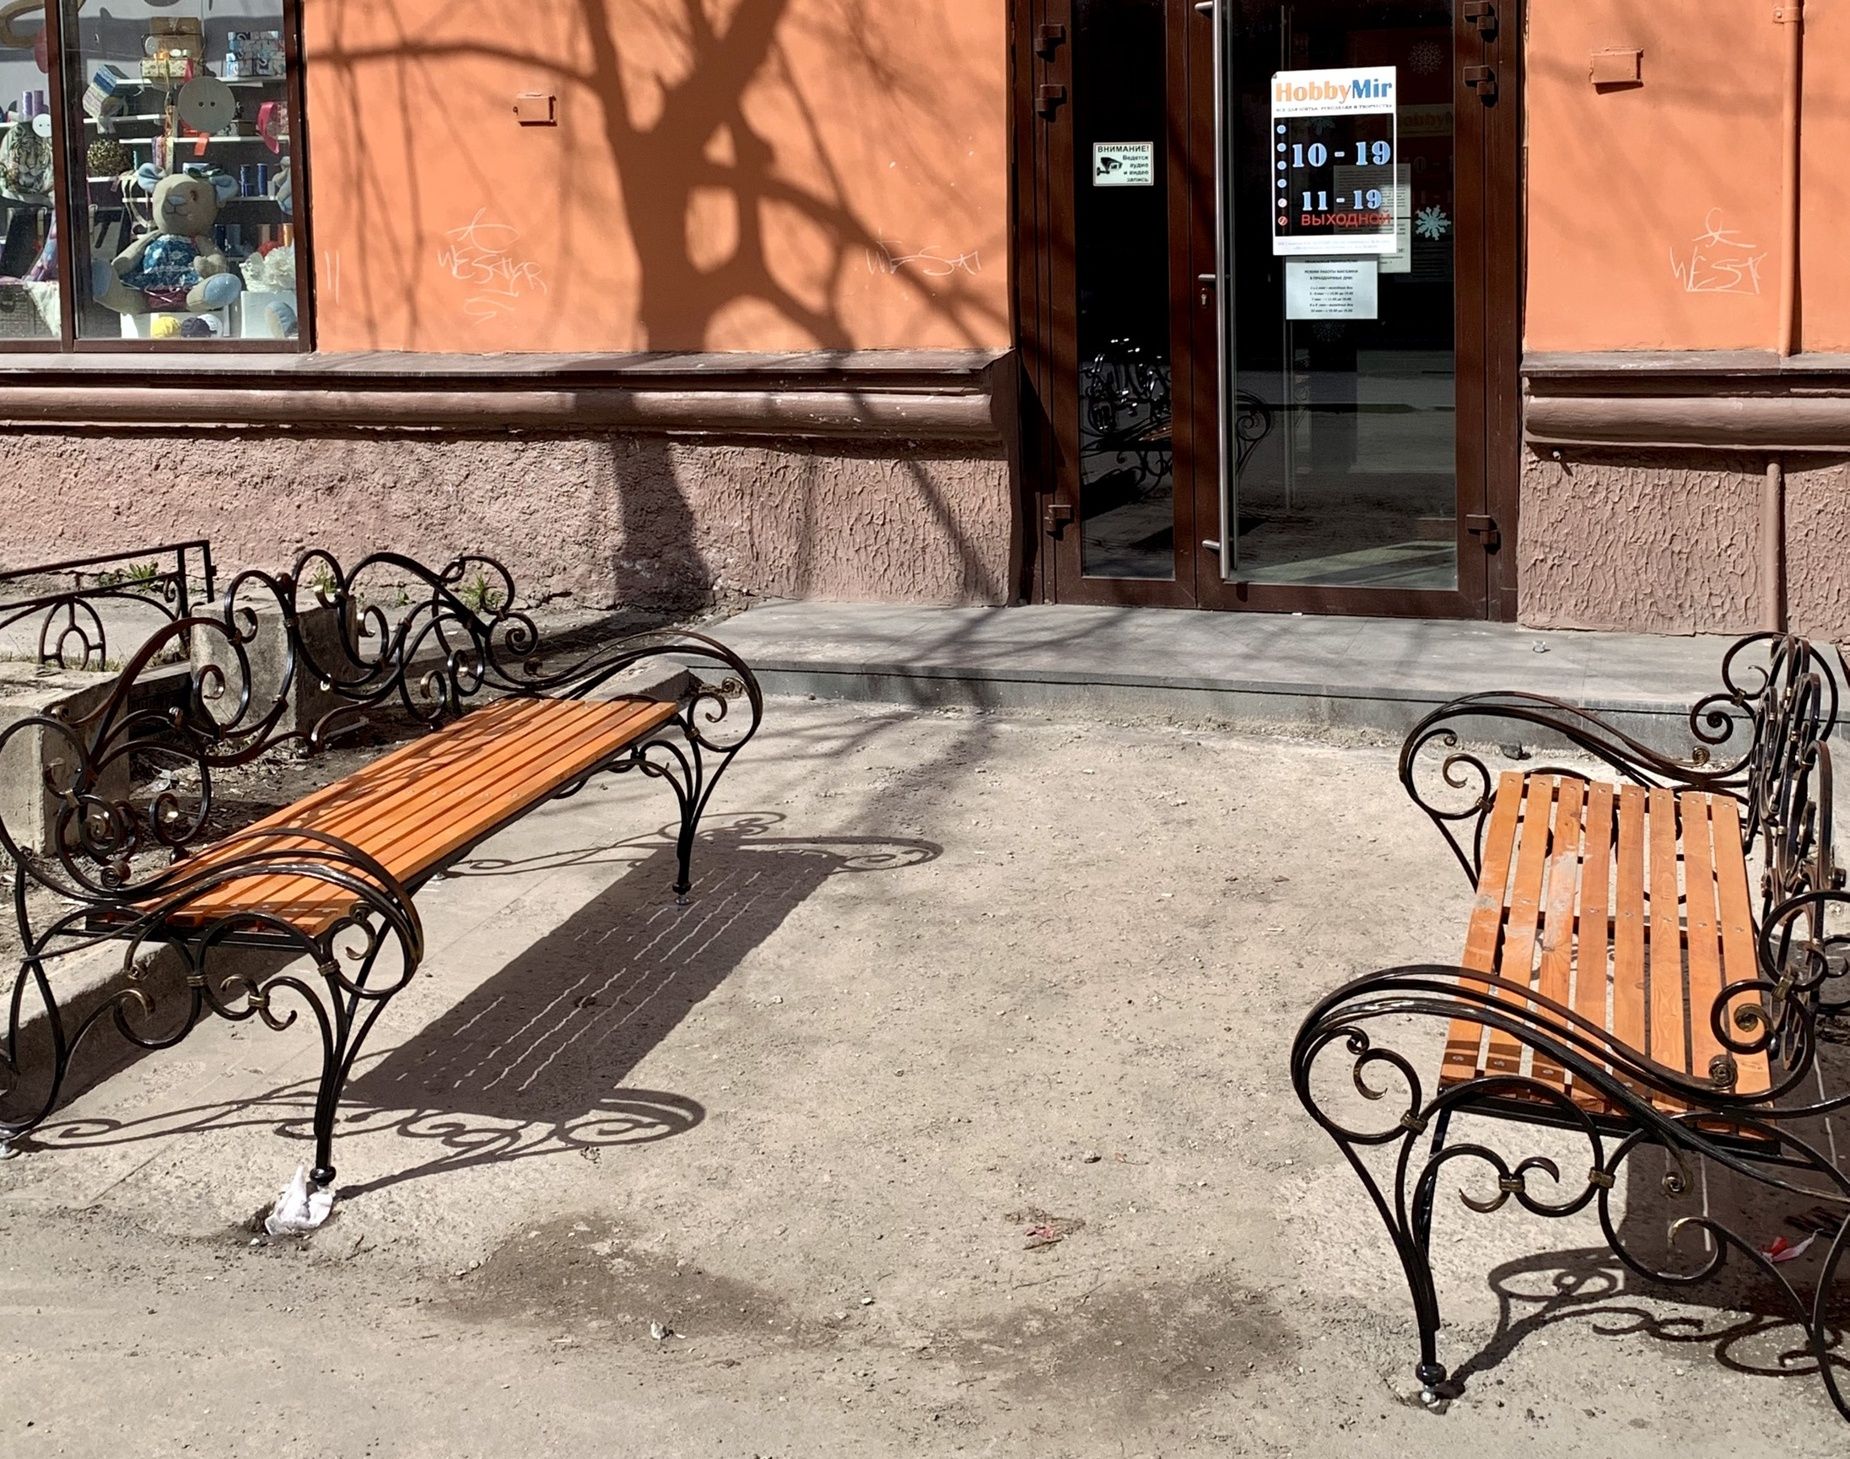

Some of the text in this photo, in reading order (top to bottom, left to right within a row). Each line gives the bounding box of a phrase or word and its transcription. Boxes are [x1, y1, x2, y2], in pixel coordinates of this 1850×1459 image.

[1276, 78, 1392, 104] HobbyMir
[1292, 143, 1327, 168] 10
[1356, 140, 1391, 166] 19
[1302, 191, 1328, 211] 11
[1353, 189, 1382, 209] 19
[1301, 209, 1391, 227] ВЫХОДНОЙ
